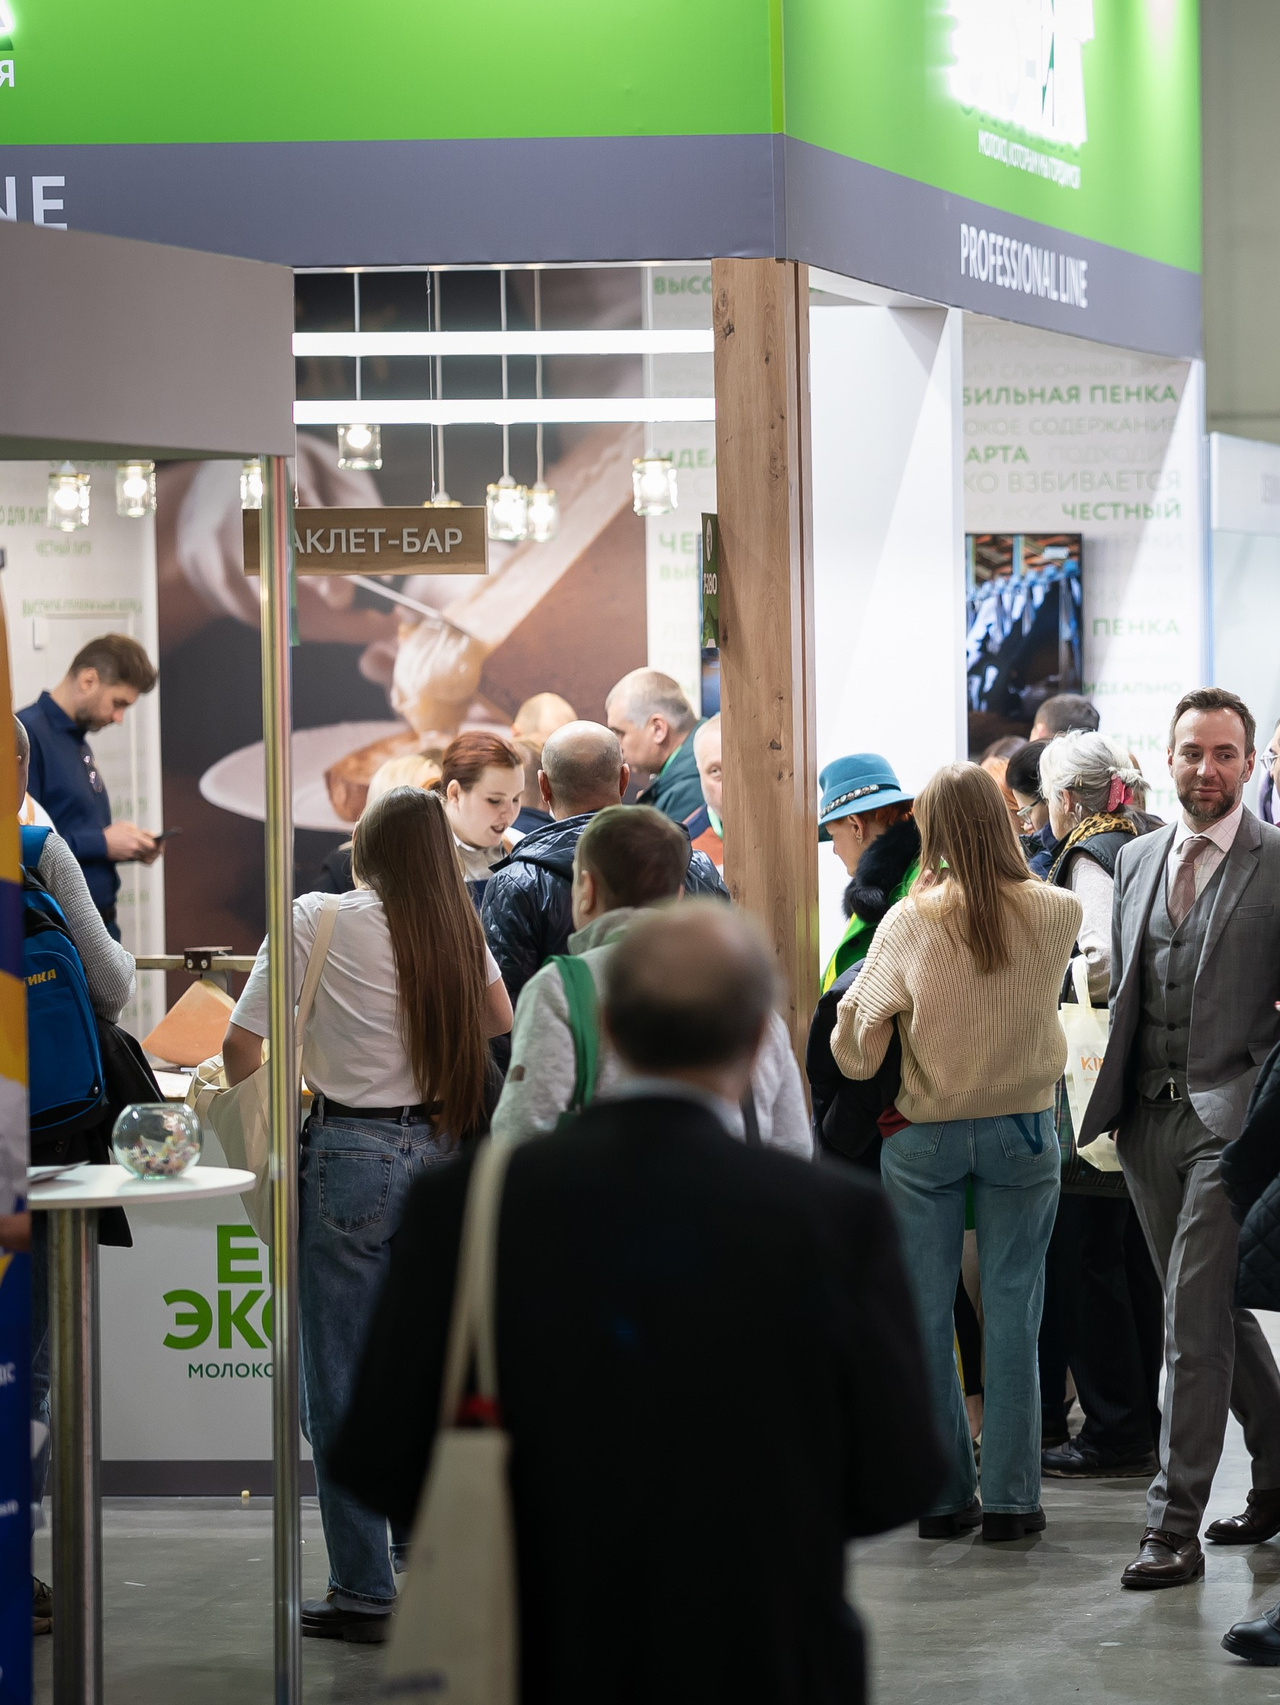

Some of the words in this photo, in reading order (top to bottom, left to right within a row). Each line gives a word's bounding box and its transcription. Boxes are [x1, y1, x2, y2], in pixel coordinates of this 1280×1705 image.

[960, 223, 1059, 301] PROFESSIONAL
[1059, 254, 1088, 309] LINE
[1089, 384, 1179, 404] ПЕНКА
[1008, 469, 1182, 494] ВЗБИВАЕТСЯ
[1062, 498, 1182, 521] ЧЕСТНЫЙ
[1092, 618, 1180, 636] ПЕНКА
